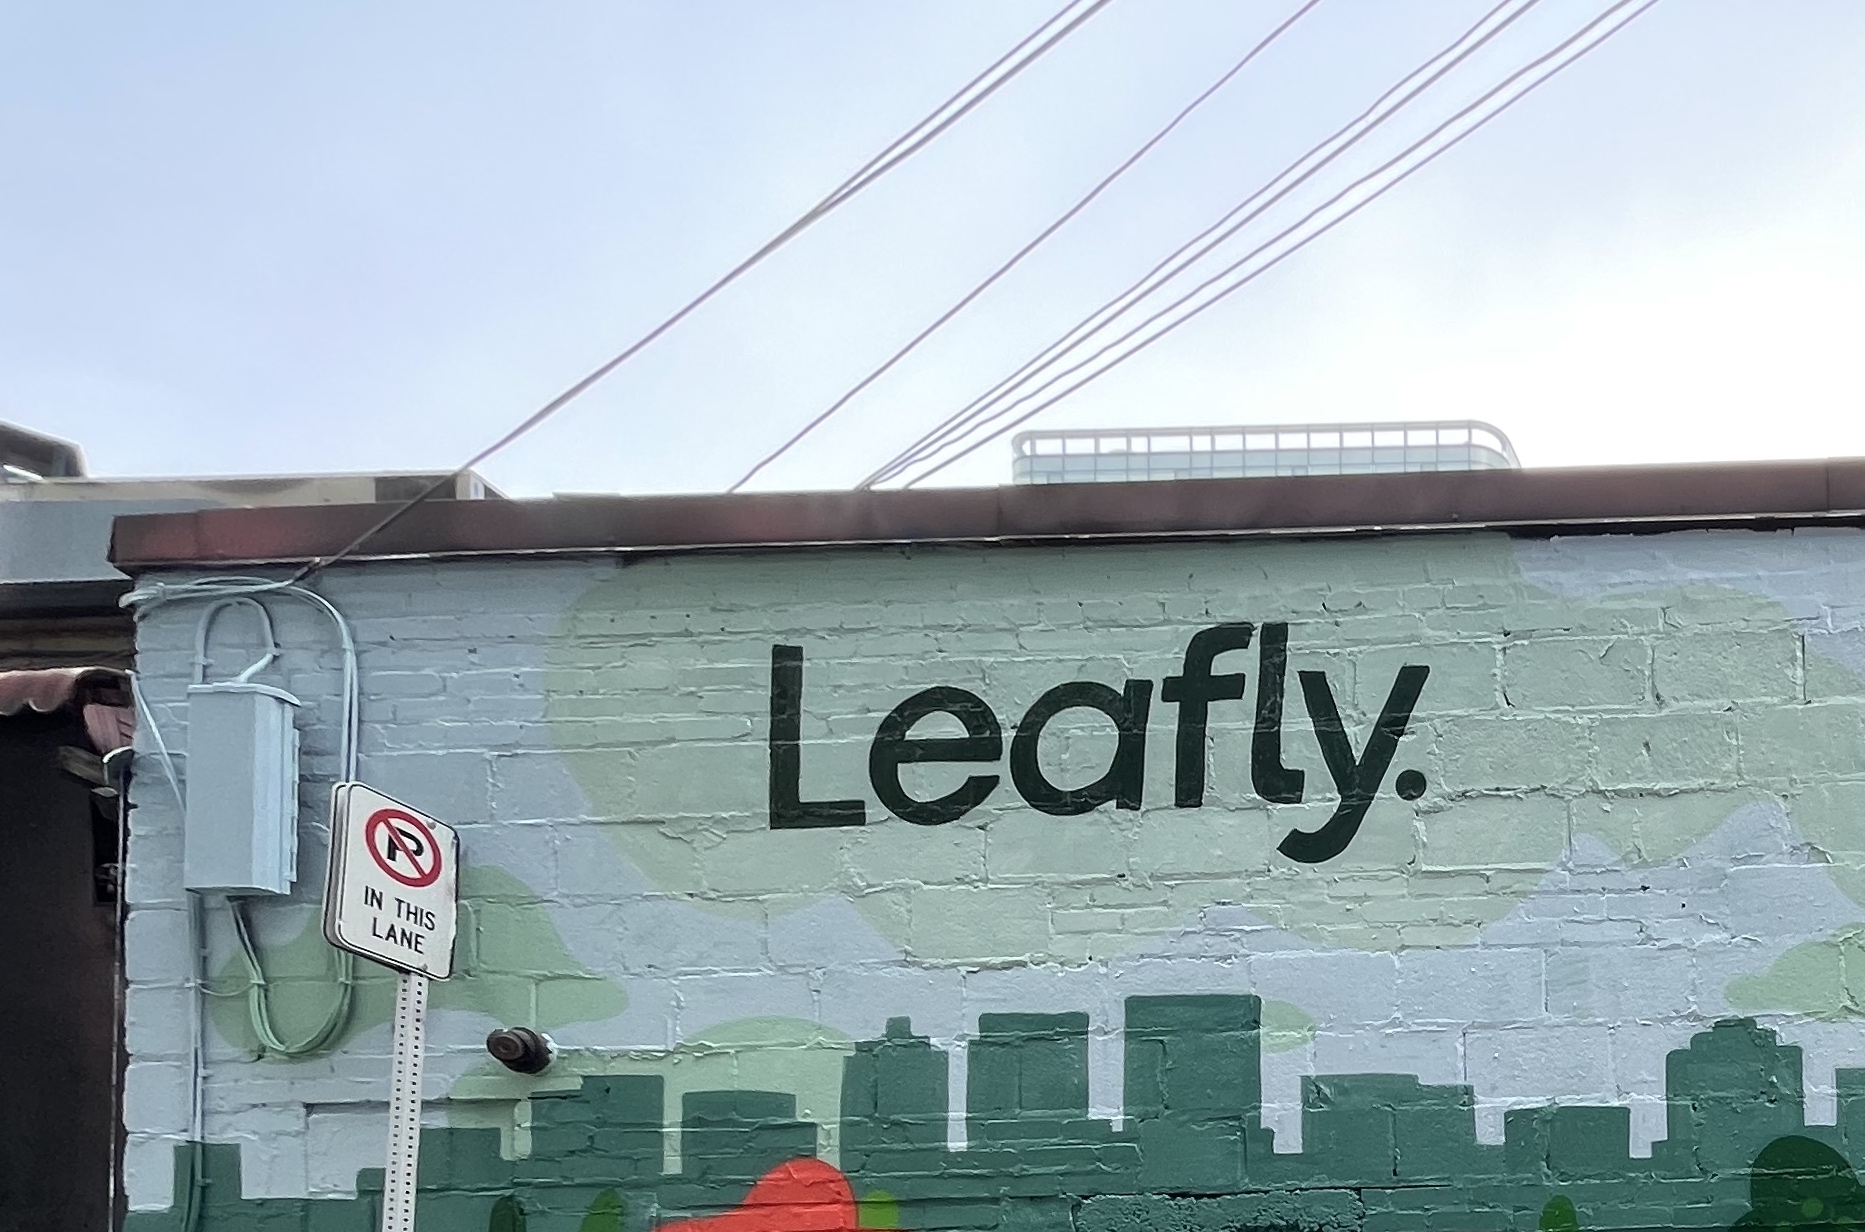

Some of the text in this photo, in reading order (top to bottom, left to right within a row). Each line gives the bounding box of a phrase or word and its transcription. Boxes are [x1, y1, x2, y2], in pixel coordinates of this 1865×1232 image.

[769, 621, 1431, 865] Leafly.
[363, 885, 436, 932] IN THIS
[371, 917, 425, 955] LANE
